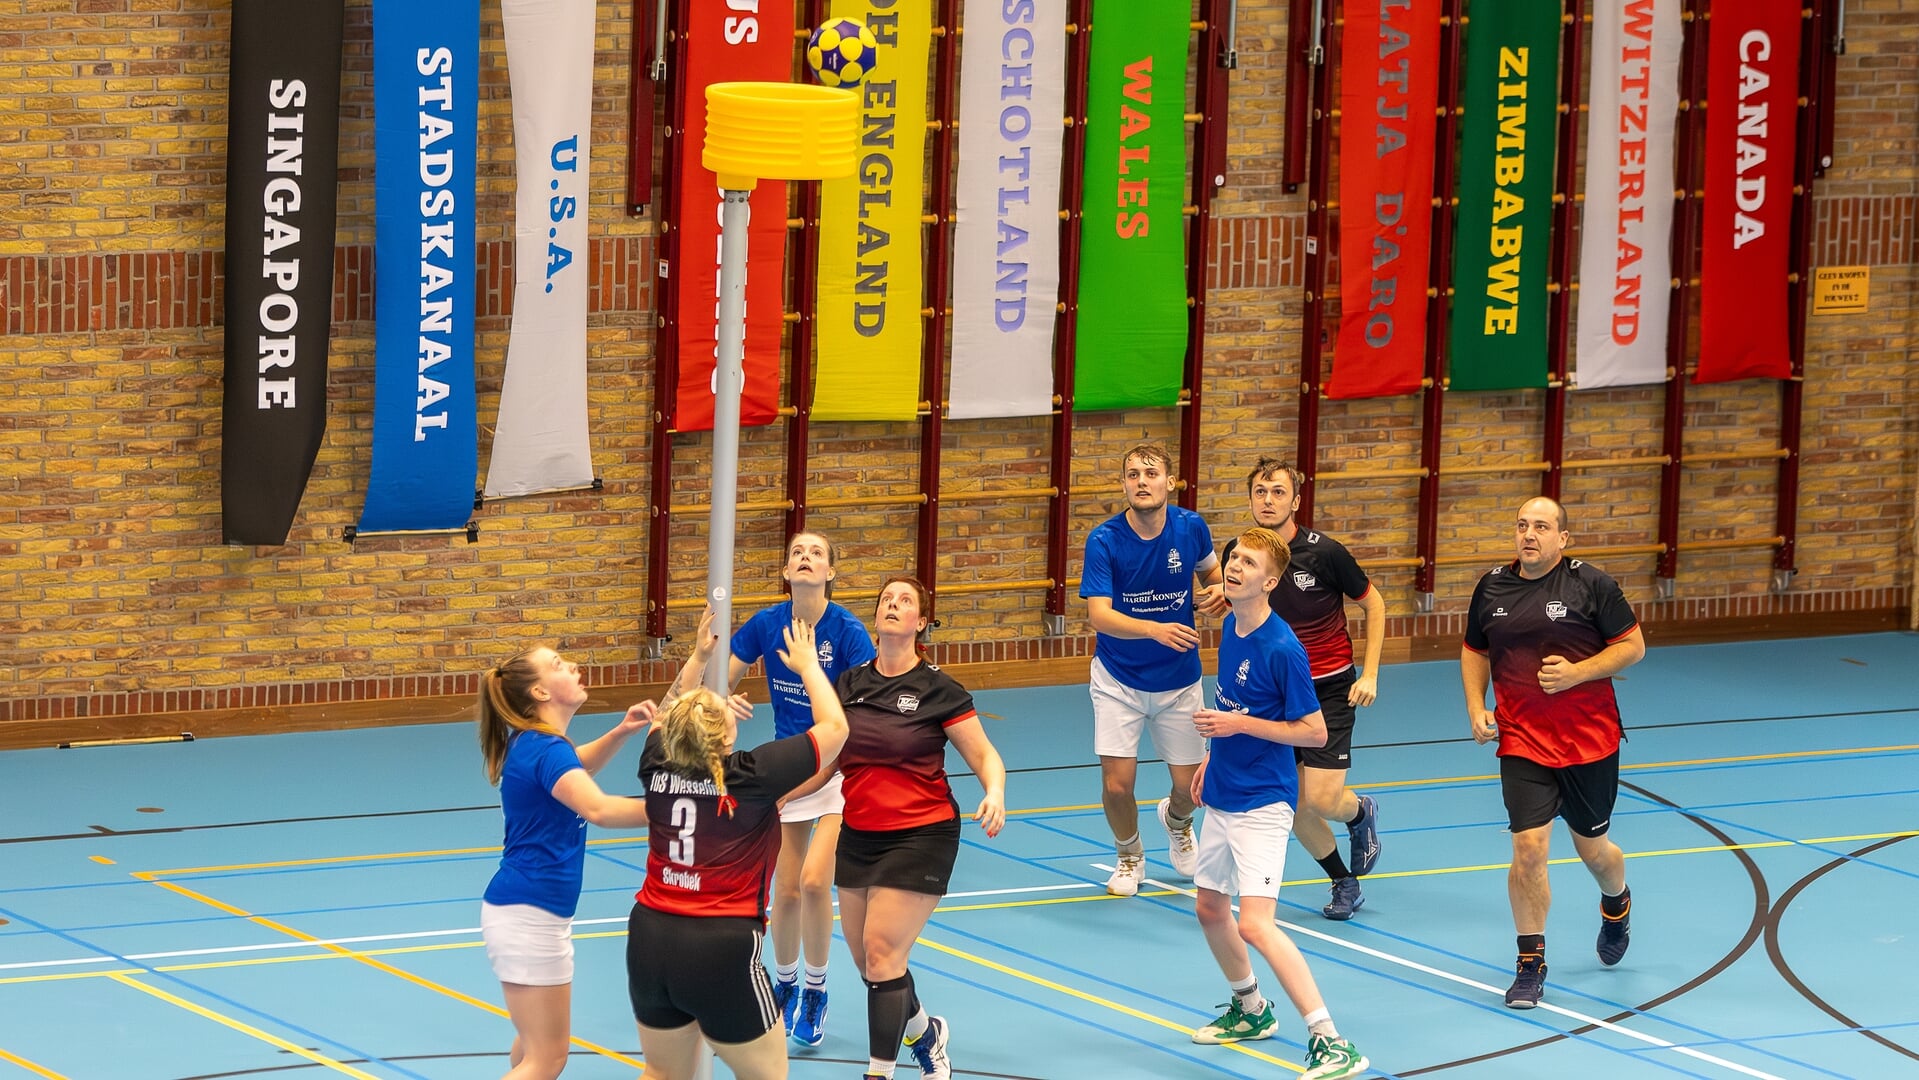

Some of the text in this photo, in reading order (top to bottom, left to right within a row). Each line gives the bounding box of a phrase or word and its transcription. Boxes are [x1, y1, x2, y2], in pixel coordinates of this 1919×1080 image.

[258, 79, 307, 410] SINGAPORE
[414, 46, 454, 442] STADSKANAAL
[545, 134, 578, 294] U.S.A.
[853, 0, 899, 338] H ENGLAND
[994, 0, 1035, 333] SCHOTLAND
[1116, 56, 1153, 239] WALES
[1365, 0, 1411, 349] LATJA D'ARO
[1484, 46, 1529, 336] ZIMBABWE
[1611, 0, 1655, 346] WITZERLAND
[1733, 29, 1771, 250] CANADA
[773, 684, 801, 696] HARRIE
[1123, 591, 1183, 604] HARRIE KONING
[662, 866, 701, 892] Skrobek
[669, 774, 727, 797] Wesselin
[669, 797, 697, 867] 3
